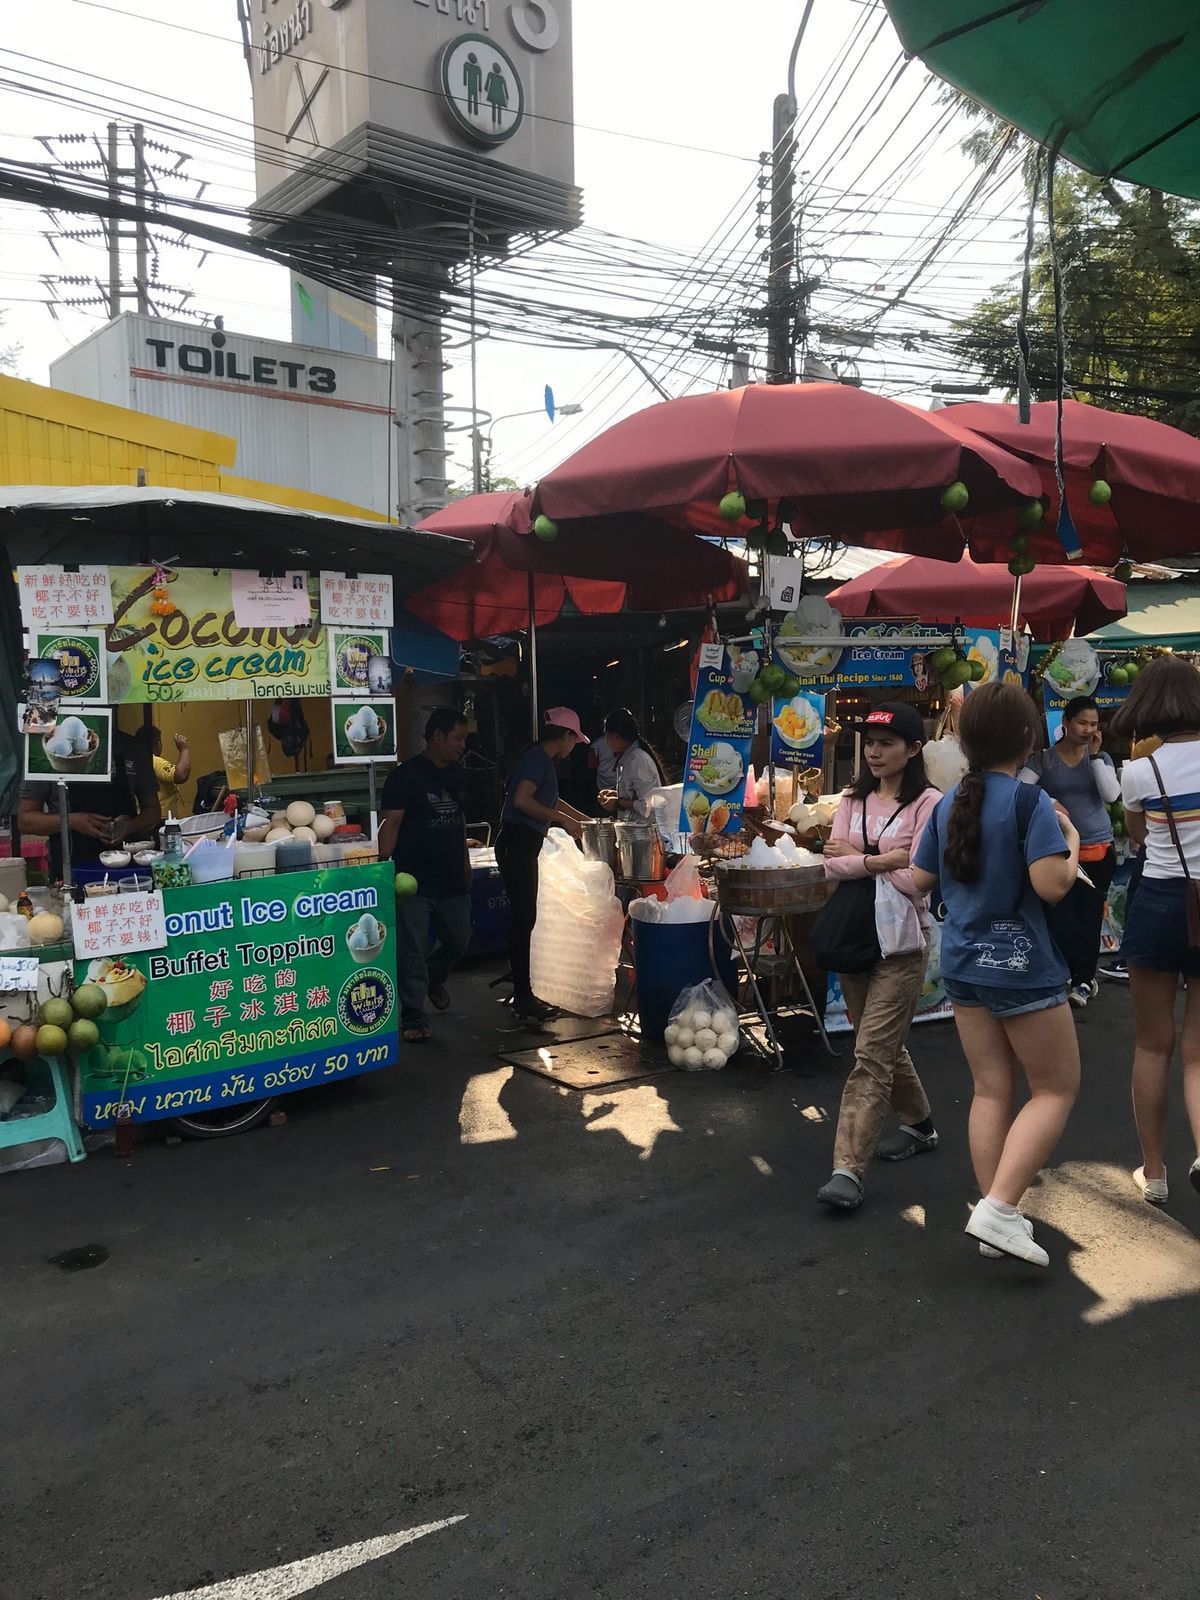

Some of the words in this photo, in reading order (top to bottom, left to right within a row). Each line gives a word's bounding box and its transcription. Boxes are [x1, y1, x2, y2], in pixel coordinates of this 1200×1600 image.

[142, 643, 197, 682] ice
[204, 647, 306, 677] cream
[852, 650, 871, 660] Ice
[873, 649, 905, 661] Cream
[708, 671, 726, 686] Cup
[797, 674, 817, 685] inal
[838, 673, 870, 685] Recipe
[691, 744, 717, 757] Shell
[242, 896, 286, 926] Ice
[297, 886, 378, 918] cream
[150, 947, 230, 981] Buffet
[236, 934, 335, 967] Topping
[209, 968, 297, 1001] 好吃的
[167, 985, 331, 1036] 椰子冰淇淋
[145, 1015, 338, 1070] ไอศกรีมกะทิสด
[155, 1083, 212, 1112] หวาน
[221, 1074, 255, 1099] มัน
[264, 1059, 317, 1090] อร่อย
[324, 1052, 349, 1076] 50
[357, 1043, 390, 1067] บาท
